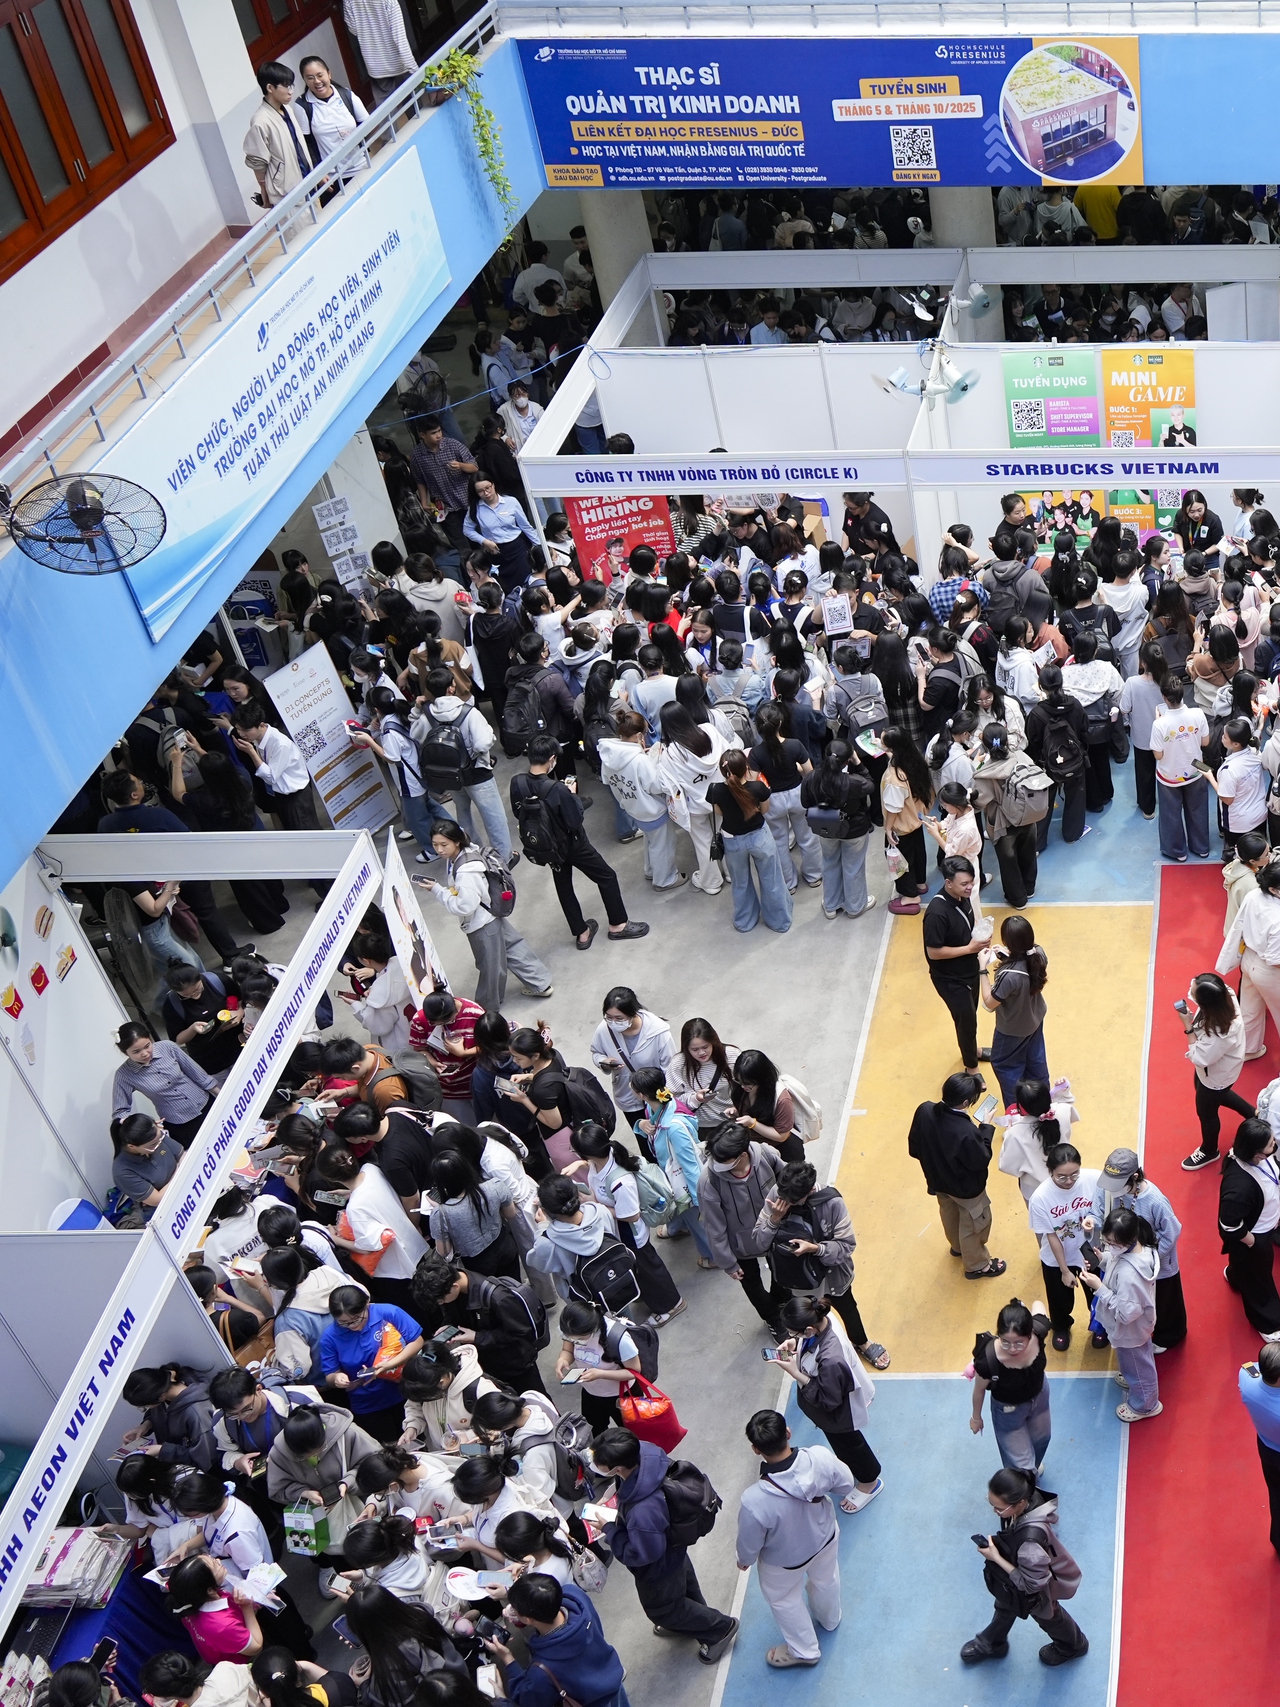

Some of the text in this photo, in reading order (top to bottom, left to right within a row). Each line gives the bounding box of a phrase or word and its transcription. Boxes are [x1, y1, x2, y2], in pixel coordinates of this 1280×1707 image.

[949, 51, 1005, 59] FRESENIUS
[634, 62, 720, 91] THẠC SĨ
[869, 79, 946, 95] TUYỂN SINH
[566, 90, 800, 119] QUẢN TRỊ KINH DOANH
[837, 101, 976, 116] THÁNG 5 & THÁNG 10/2025
[577, 122, 799, 140] LIÊN KẾT ĐẠI HỌC FRESENIUS ĐỨC
[167, 454, 195, 493] VIÊN
[196, 418, 234, 461] CHỨC,
[232, 376, 268, 421] NGƯỜI
[266, 353, 287, 384] LAO
[287, 322, 320, 360] ĐỘNG,
[317, 295, 339, 328] HỌC
[339, 275, 364, 306] VIÊN,
[362, 249, 381, 279] SINH
[380, 230, 401, 260] VIÊN
[213, 280, 383, 478] TRƯỜNG ĐẠI HỌC MỞ TP. HỒ CHÍ MINH
[1013, 373, 1087, 389] TUYỂN DỤNG
[1112, 371, 1157, 386] MINI
[242, 321, 375, 483] TUÂN THỦ LUẬT AN NINH MẠNG
[1129, 385, 1187, 403] GAME
[575, 464, 858, 483] CÔNG TY TNHH VÒNG TRÒN ĐỎ (CIRCLE K)
[986, 462, 1220, 476] STARBUCKS VIETNAM
[581, 497, 653, 525] HIRING
[631, 519, 664, 530] hot job
[170, 863, 372, 1240] CÔNG TY CỔ PHẦN GOOD DAY HOSPITALITY (MCDONALD'S VIETNAM)
[1050, 1197, 1093, 1218] Sài Gòn
[22, 1444, 68, 1533] AEON
[65, 1377, 100, 1441] VIỆT
[98, 1307, 136, 1377] NAM
